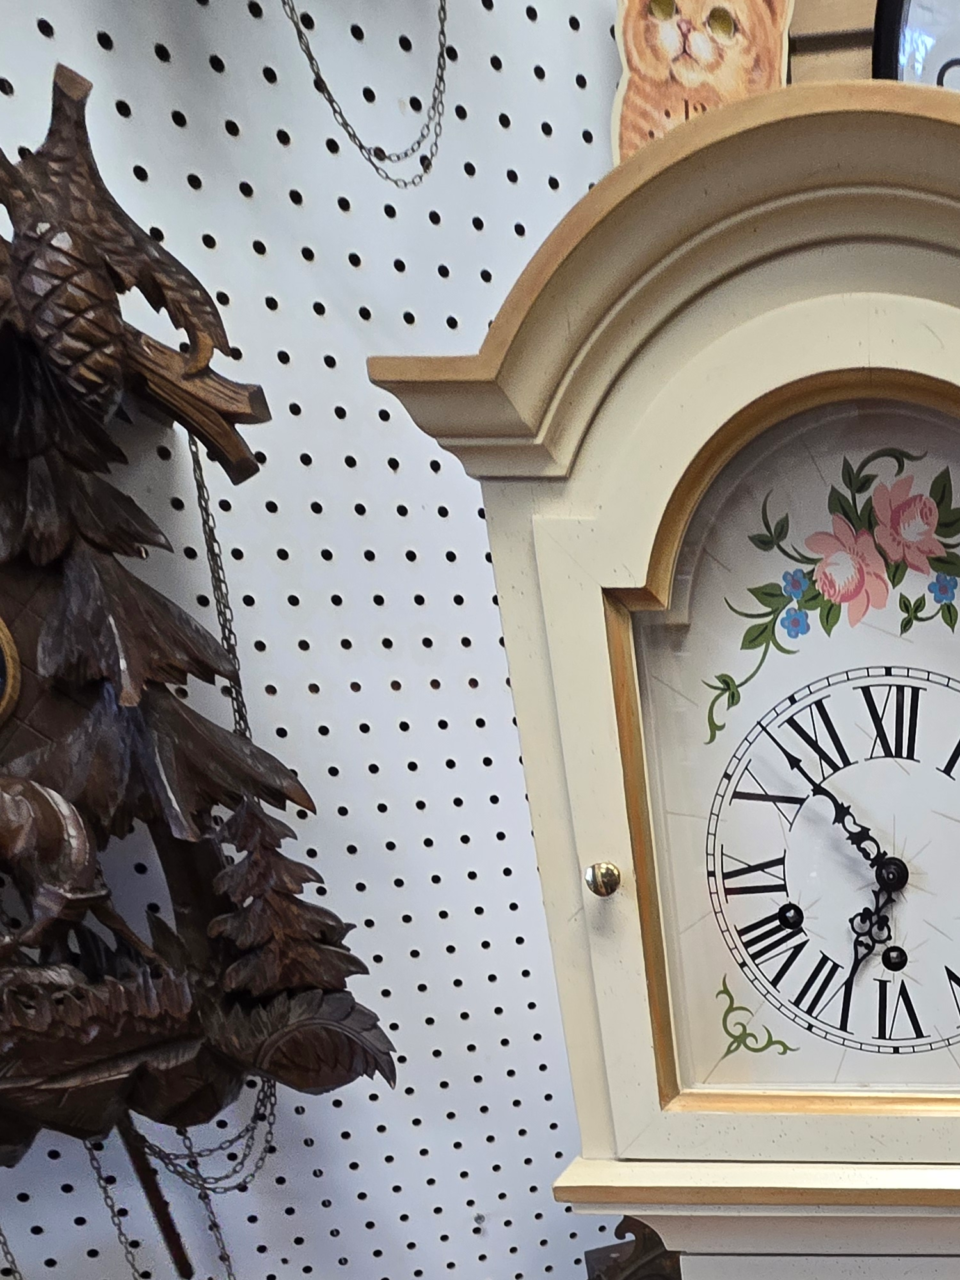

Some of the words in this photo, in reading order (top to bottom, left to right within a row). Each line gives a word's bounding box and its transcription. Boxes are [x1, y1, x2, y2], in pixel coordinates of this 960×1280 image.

[777, 695, 859, 782] XI
[853, 684, 927, 762] XII
[729, 758, 810, 832] X
[720, 843, 789, 904] IX
[734, 908, 810, 993] VIII
[788, 950, 854, 1035] VII
[872, 978, 931, 1041] VI
